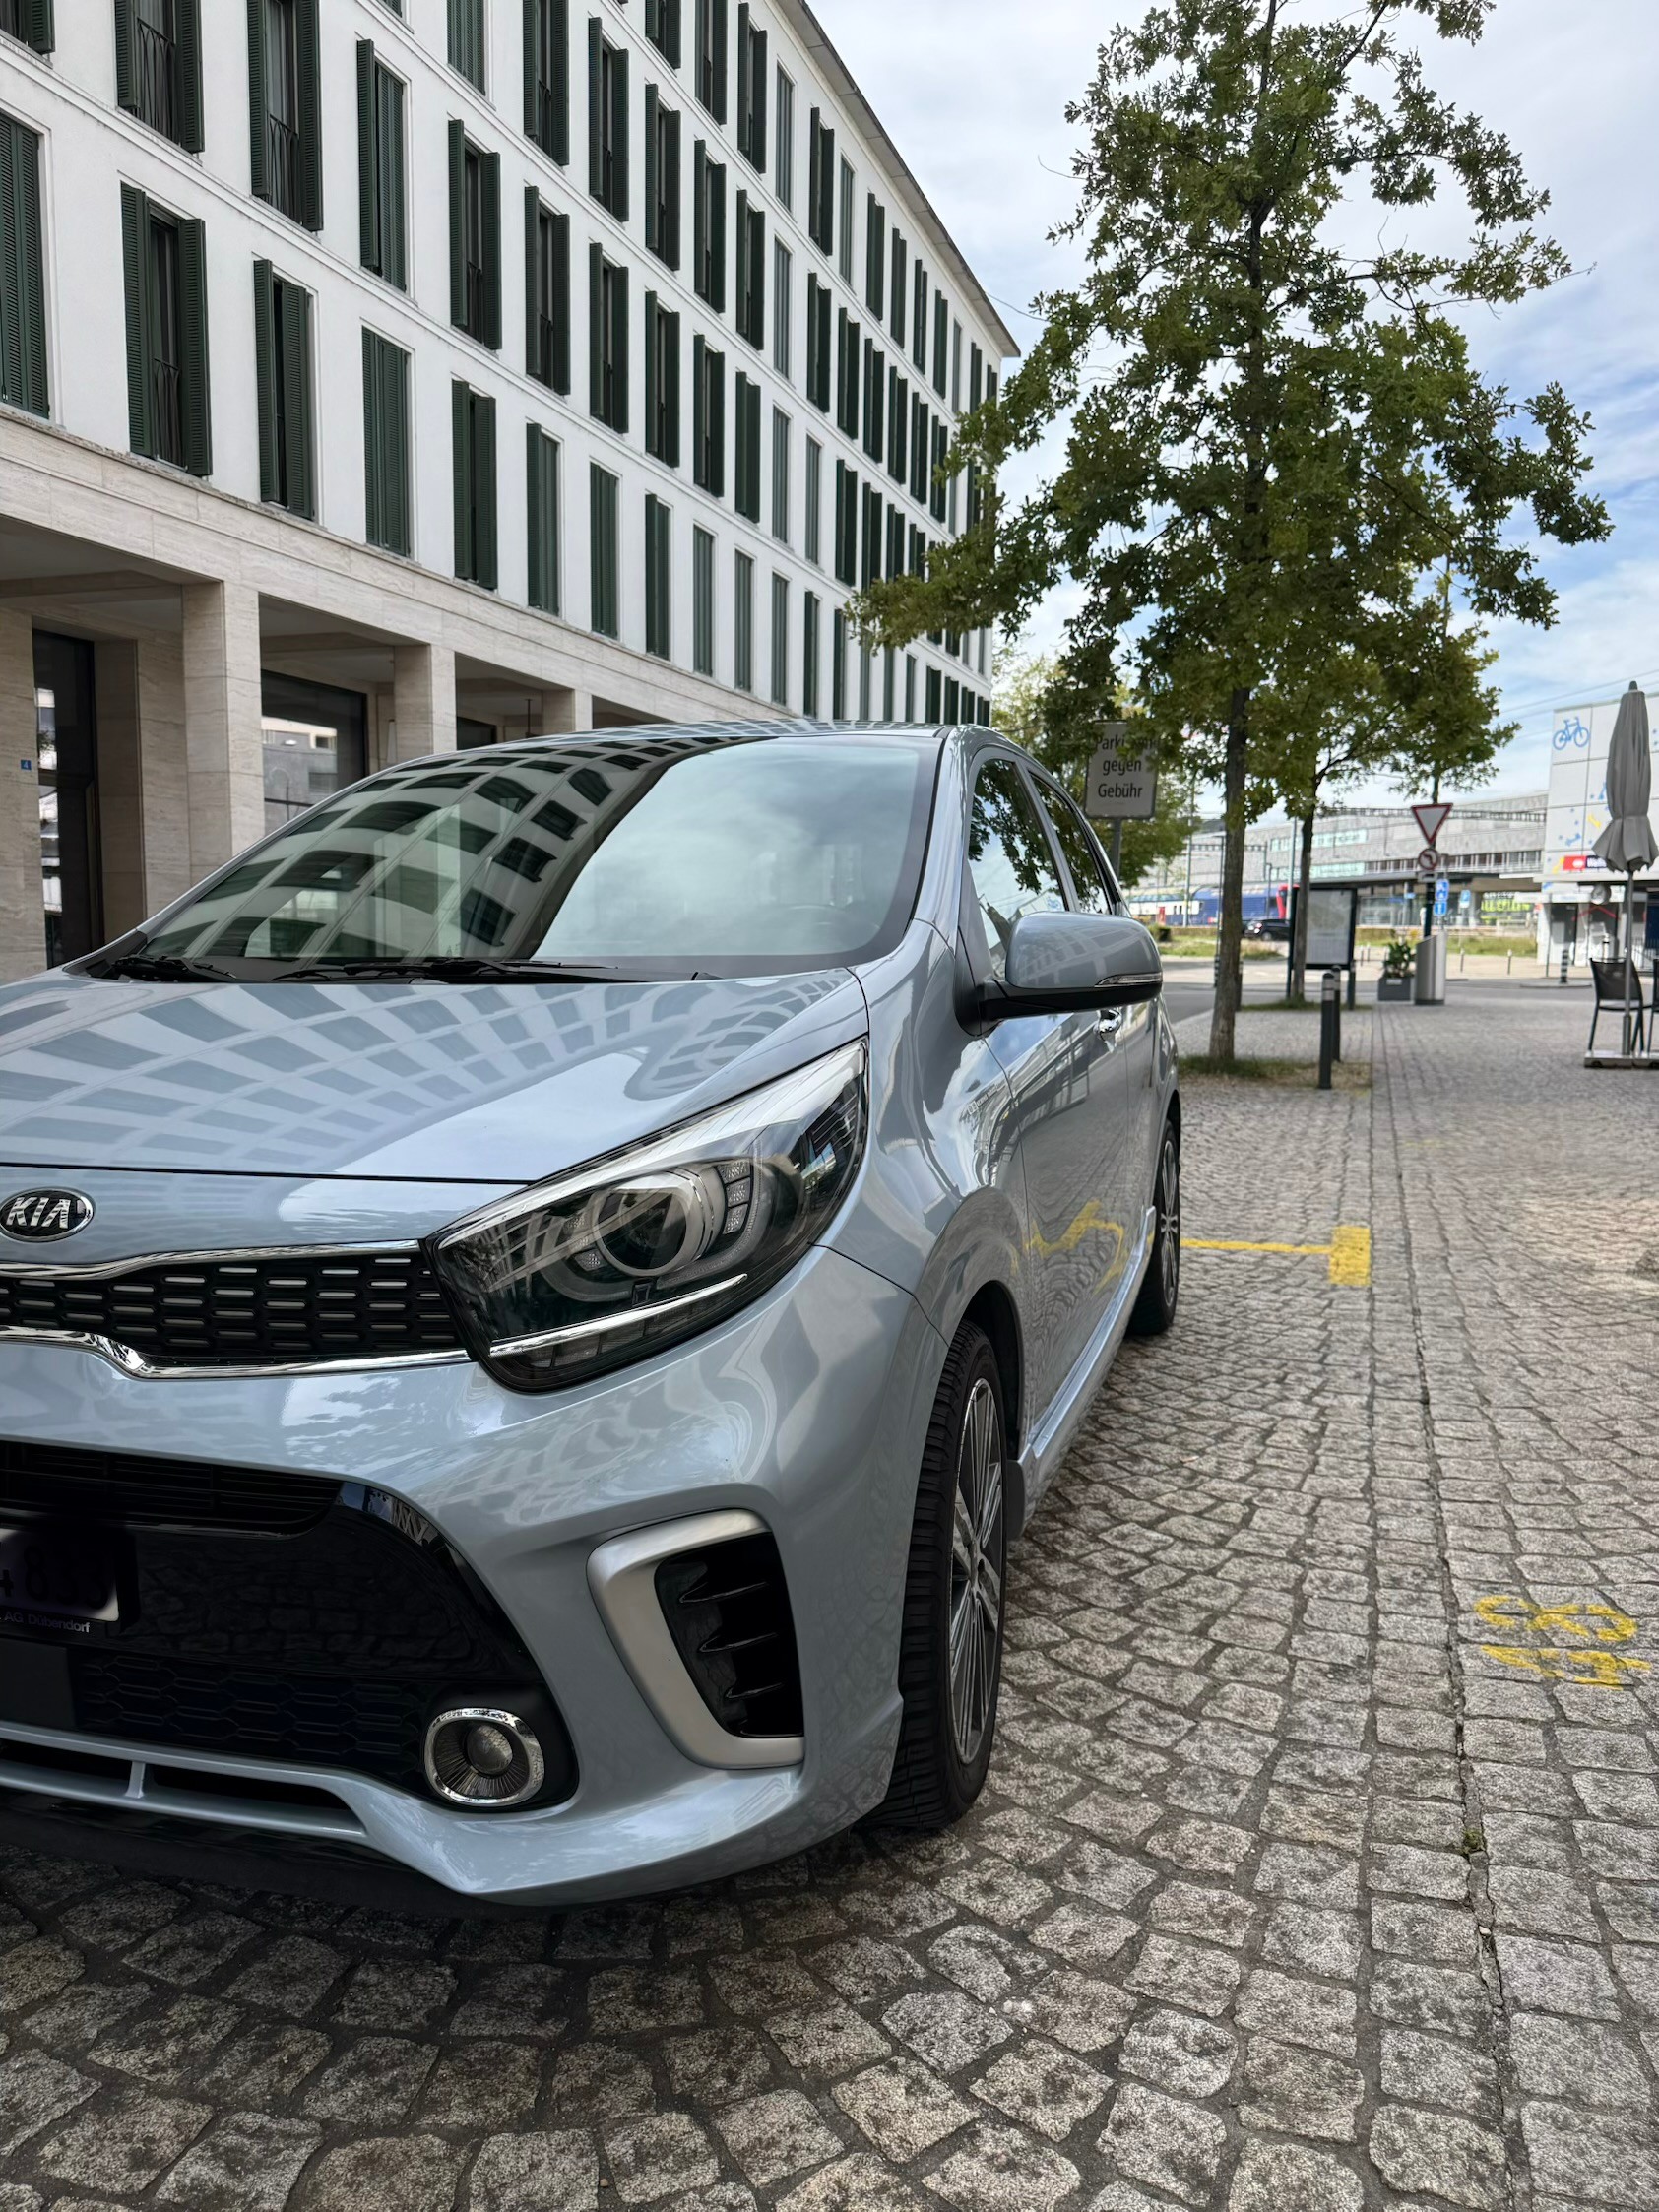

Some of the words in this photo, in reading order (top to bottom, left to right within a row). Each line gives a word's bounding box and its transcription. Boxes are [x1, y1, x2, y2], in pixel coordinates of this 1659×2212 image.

[1102, 759, 1142, 776] gegen
[1098, 782, 1143, 798] Gebühr
[6, 1196, 71, 1230] KIA
